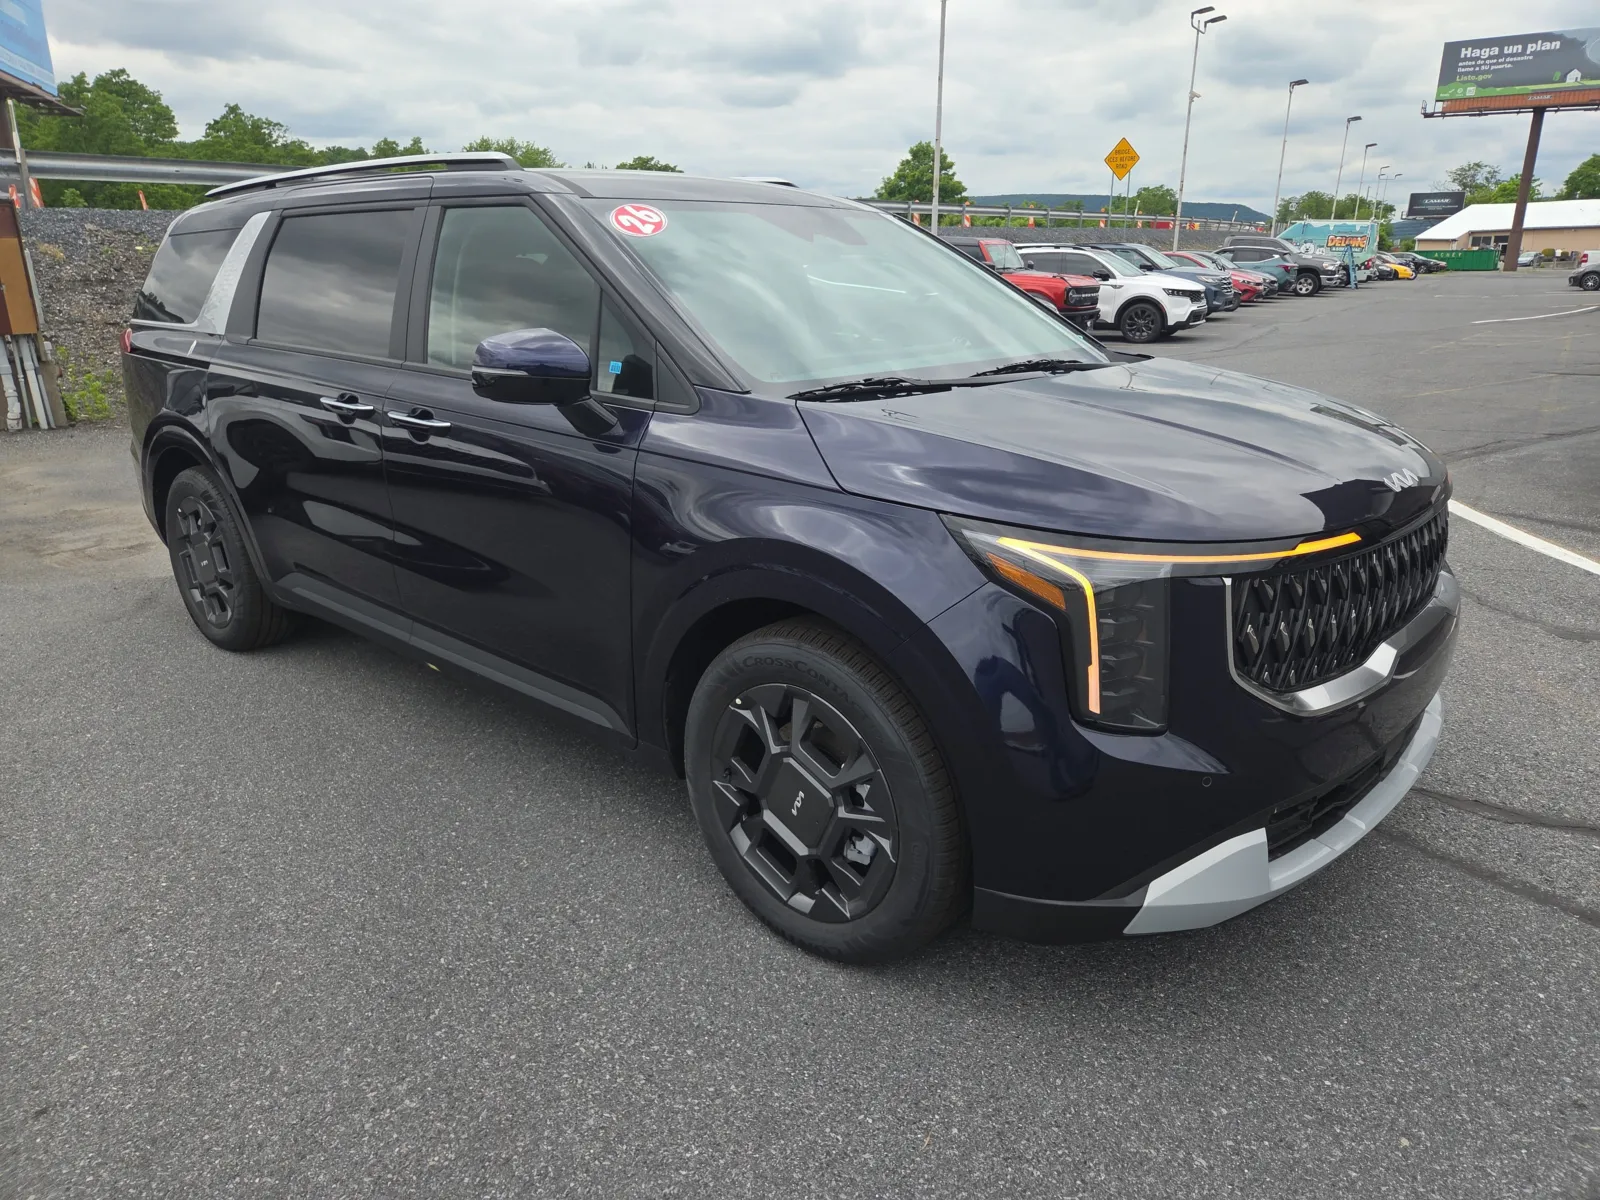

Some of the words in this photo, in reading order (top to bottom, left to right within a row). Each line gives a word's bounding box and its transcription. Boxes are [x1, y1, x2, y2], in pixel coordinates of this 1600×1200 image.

[1460, 46, 1499, 59] Haga
[1503, 44, 1522, 54] un
[1527, 39, 1561, 55] plan
[1456, 73, 1493, 82] Listo.gov
[617, 205, 662, 234] 26
